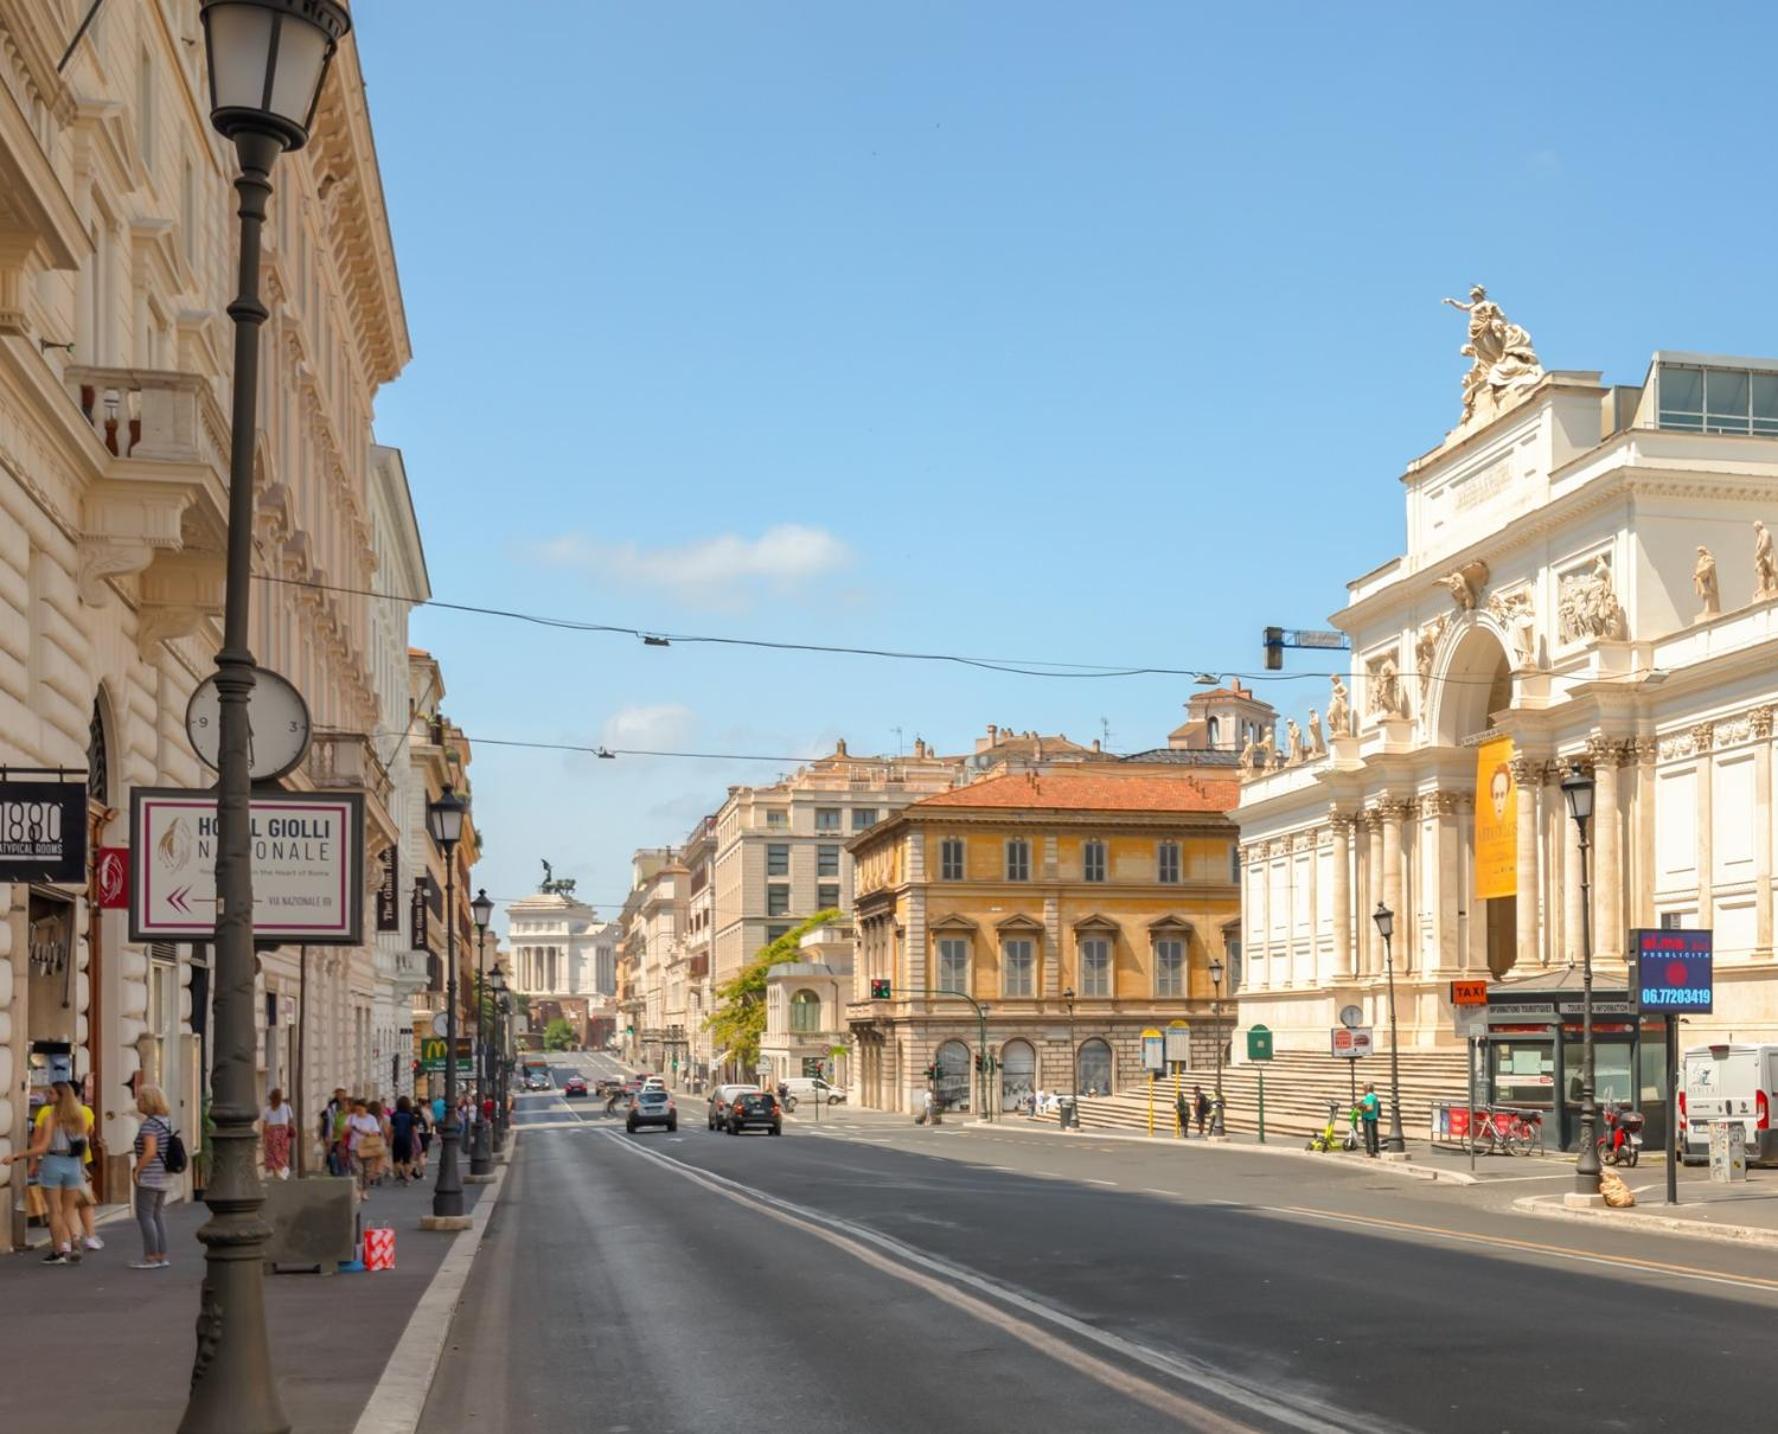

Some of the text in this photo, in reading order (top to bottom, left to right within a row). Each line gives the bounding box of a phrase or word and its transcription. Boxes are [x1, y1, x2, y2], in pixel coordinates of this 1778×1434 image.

[199, 716, 208, 728] 9
[290, 720, 298, 733] 3
[268, 818, 330, 839] GIOLLI
[36, 843, 63, 854] ROOMS
[198, 840, 329, 861] NONALE
[269, 896, 284, 906] VIA
[286, 896, 321, 907] NAZIONALE
[383, 901, 394, 921] The
[1456, 987, 1485, 998] TAXI
[1642, 988, 1711, 1004] 06.77203419
